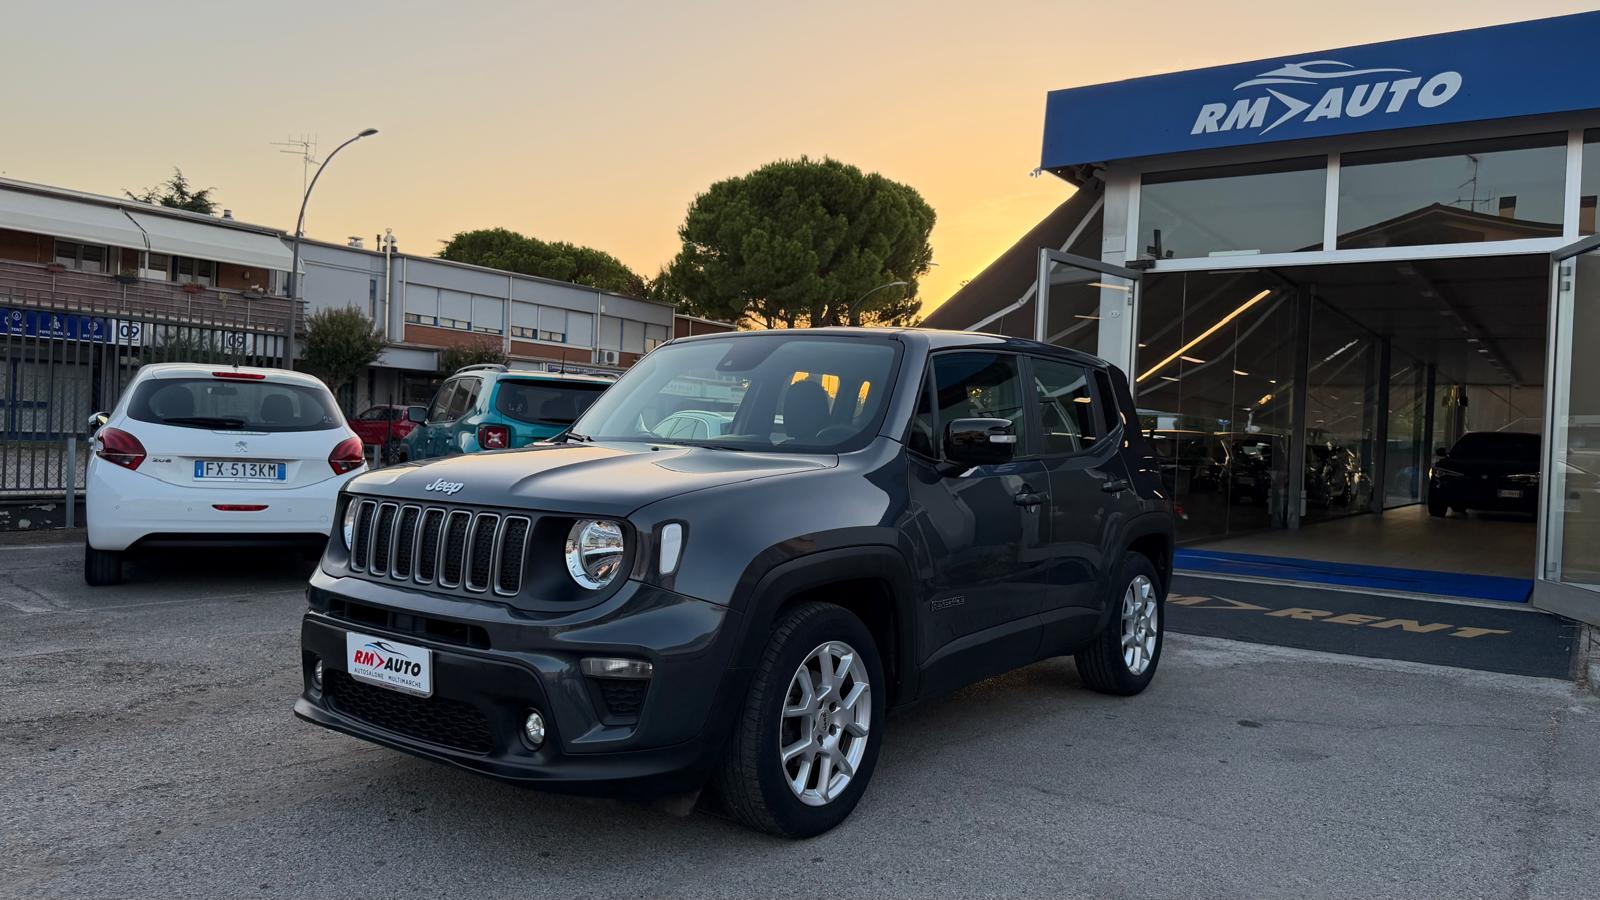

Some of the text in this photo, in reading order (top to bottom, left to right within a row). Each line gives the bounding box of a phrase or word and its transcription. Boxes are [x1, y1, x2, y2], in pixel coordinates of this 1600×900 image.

[1190, 71, 1463, 135] RM AUTO
[425, 478, 464, 495] Jeep
[1264, 607, 1512, 638] RENT
[354, 650, 421, 676] RM AUTO
[354, 667, 384, 679] AUTOSALONE
